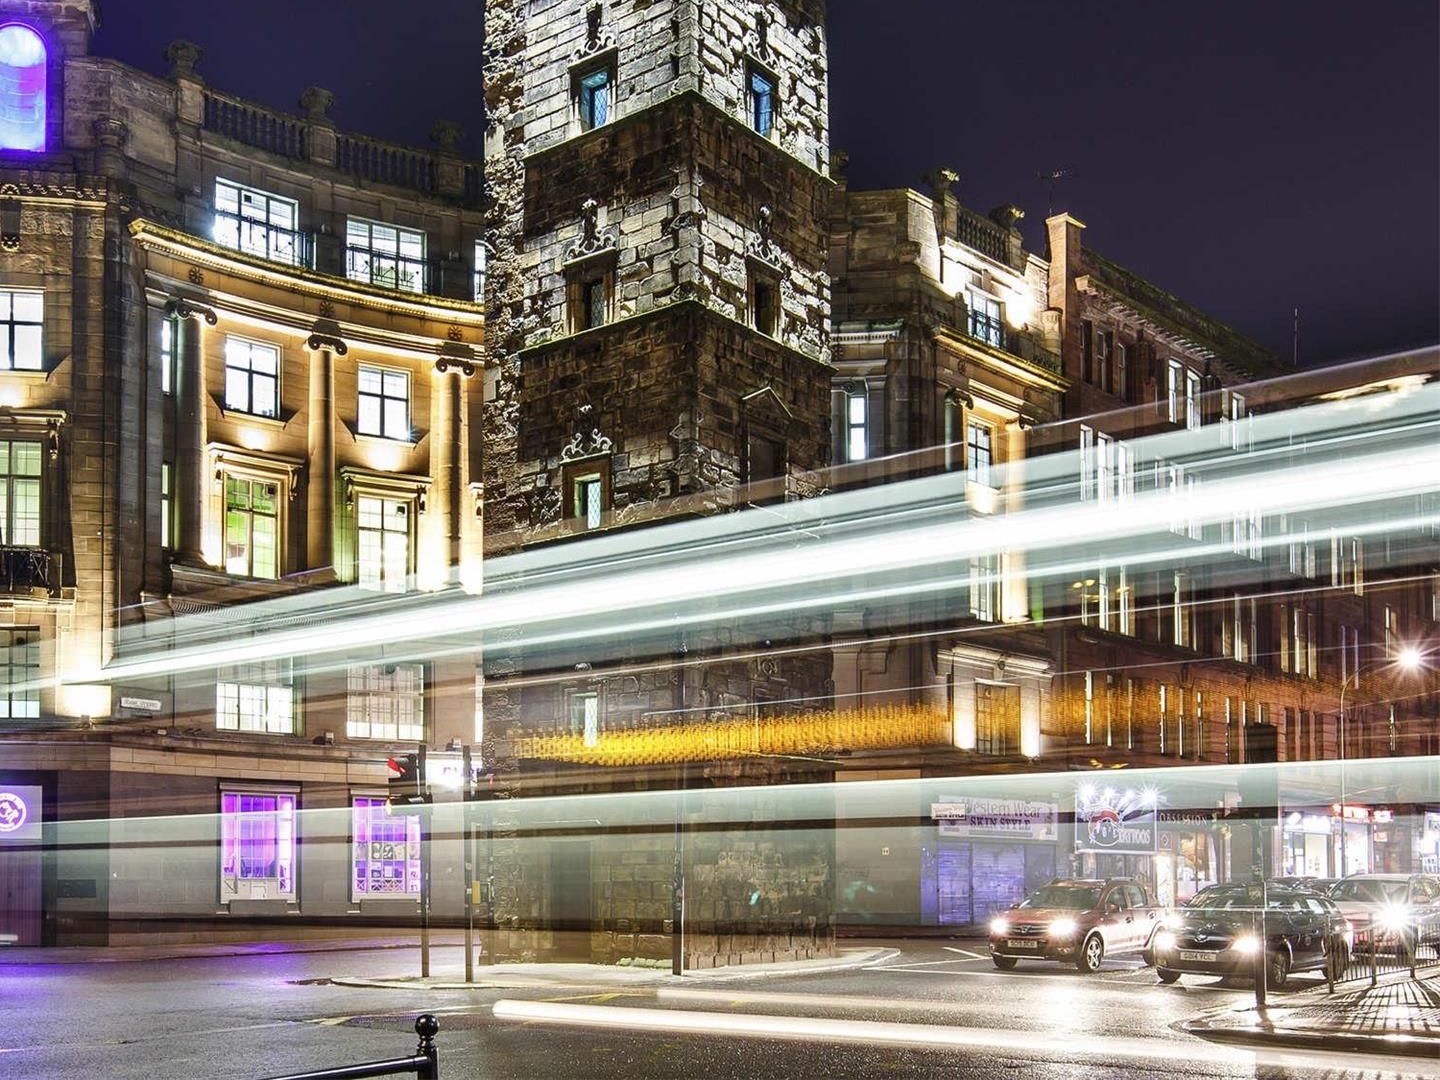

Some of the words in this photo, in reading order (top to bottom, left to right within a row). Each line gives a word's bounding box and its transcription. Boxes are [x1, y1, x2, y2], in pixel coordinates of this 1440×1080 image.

[1014, 799, 1041, 818] Wear
[969, 816, 997, 827] SKIN
[1000, 818, 1031, 831] STYLE
[1159, 812, 1208, 826] OBSESSION
